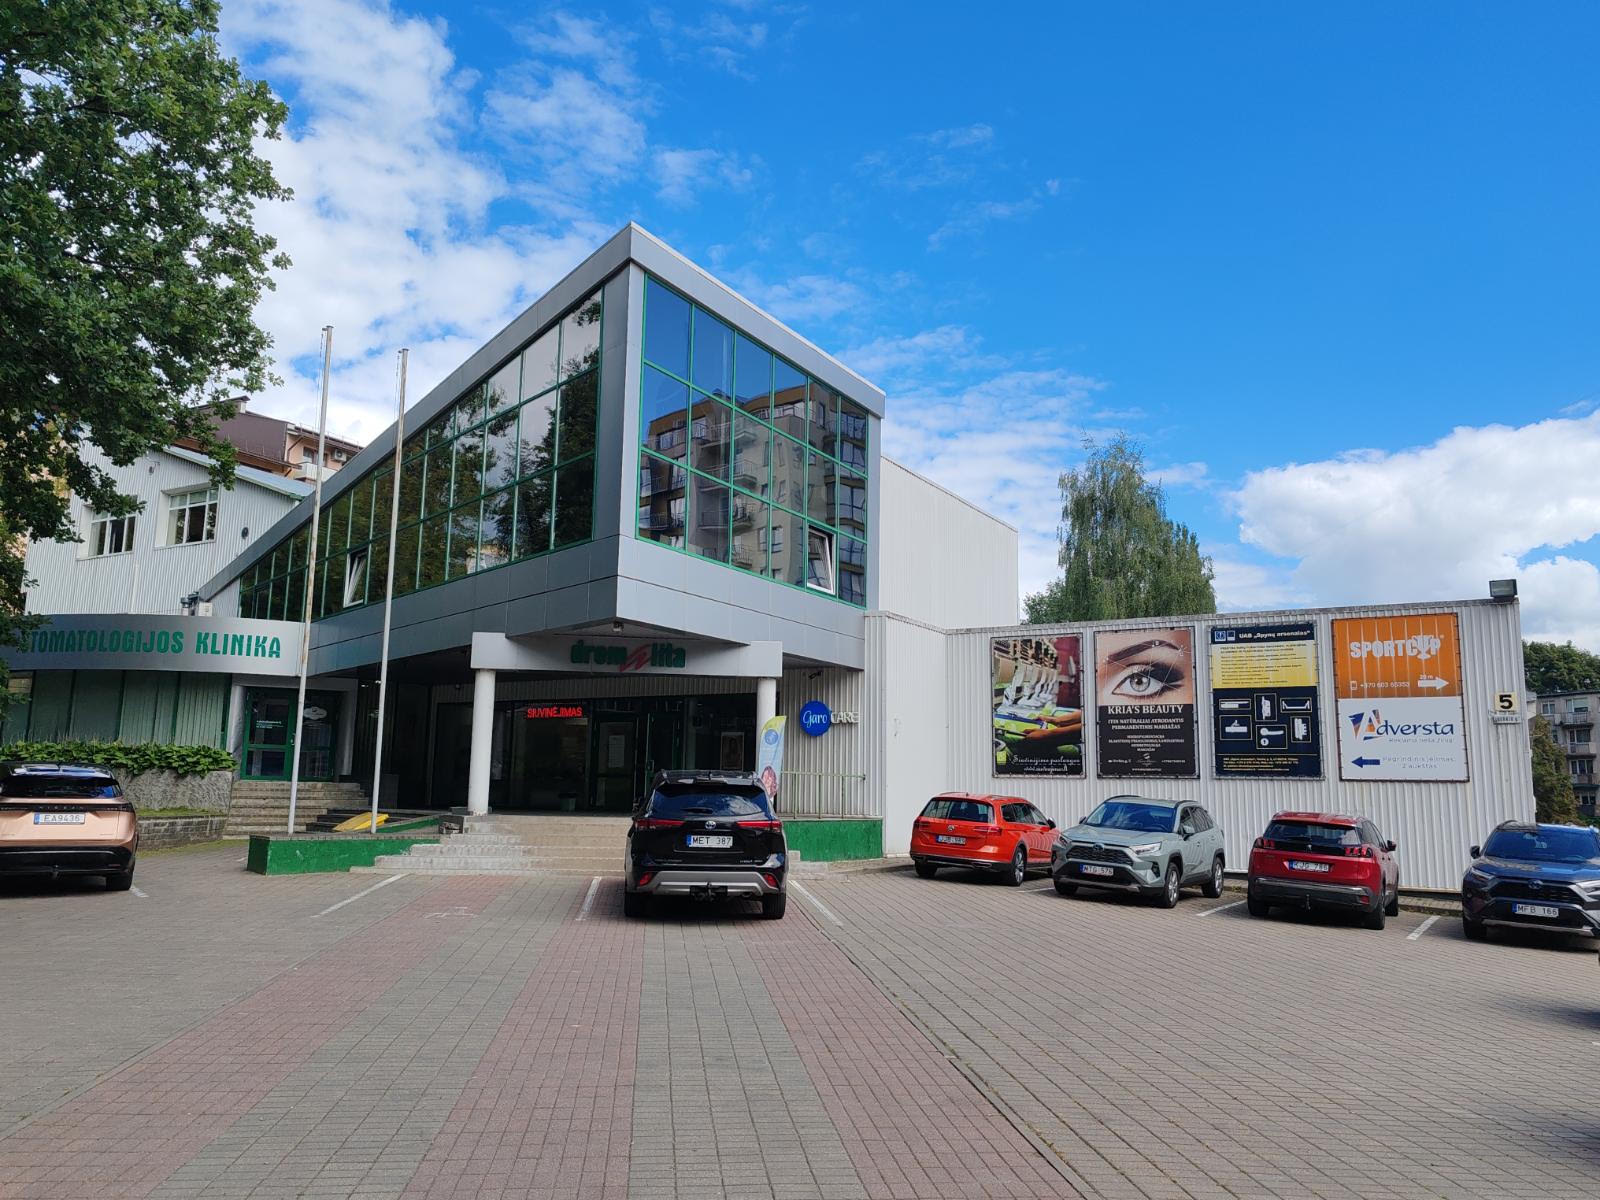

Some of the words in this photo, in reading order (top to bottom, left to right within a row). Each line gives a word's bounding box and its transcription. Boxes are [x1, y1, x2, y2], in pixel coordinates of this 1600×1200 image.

[22, 630, 184, 654] TOMATOLOGIJOS
[195, 632, 281, 658] KLINIKA
[1350, 635, 1441, 659] SPORTCUP
[1108, 705, 1140, 714] KRIA'S
[1142, 704, 1184, 714] BEAUTY
[1499, 694, 1513, 709] 5
[830, 711, 860, 724] CARE
[1356, 709, 1454, 741] Adversta
[692, 836, 710, 845] MET
[716, 837, 732, 846] 387
